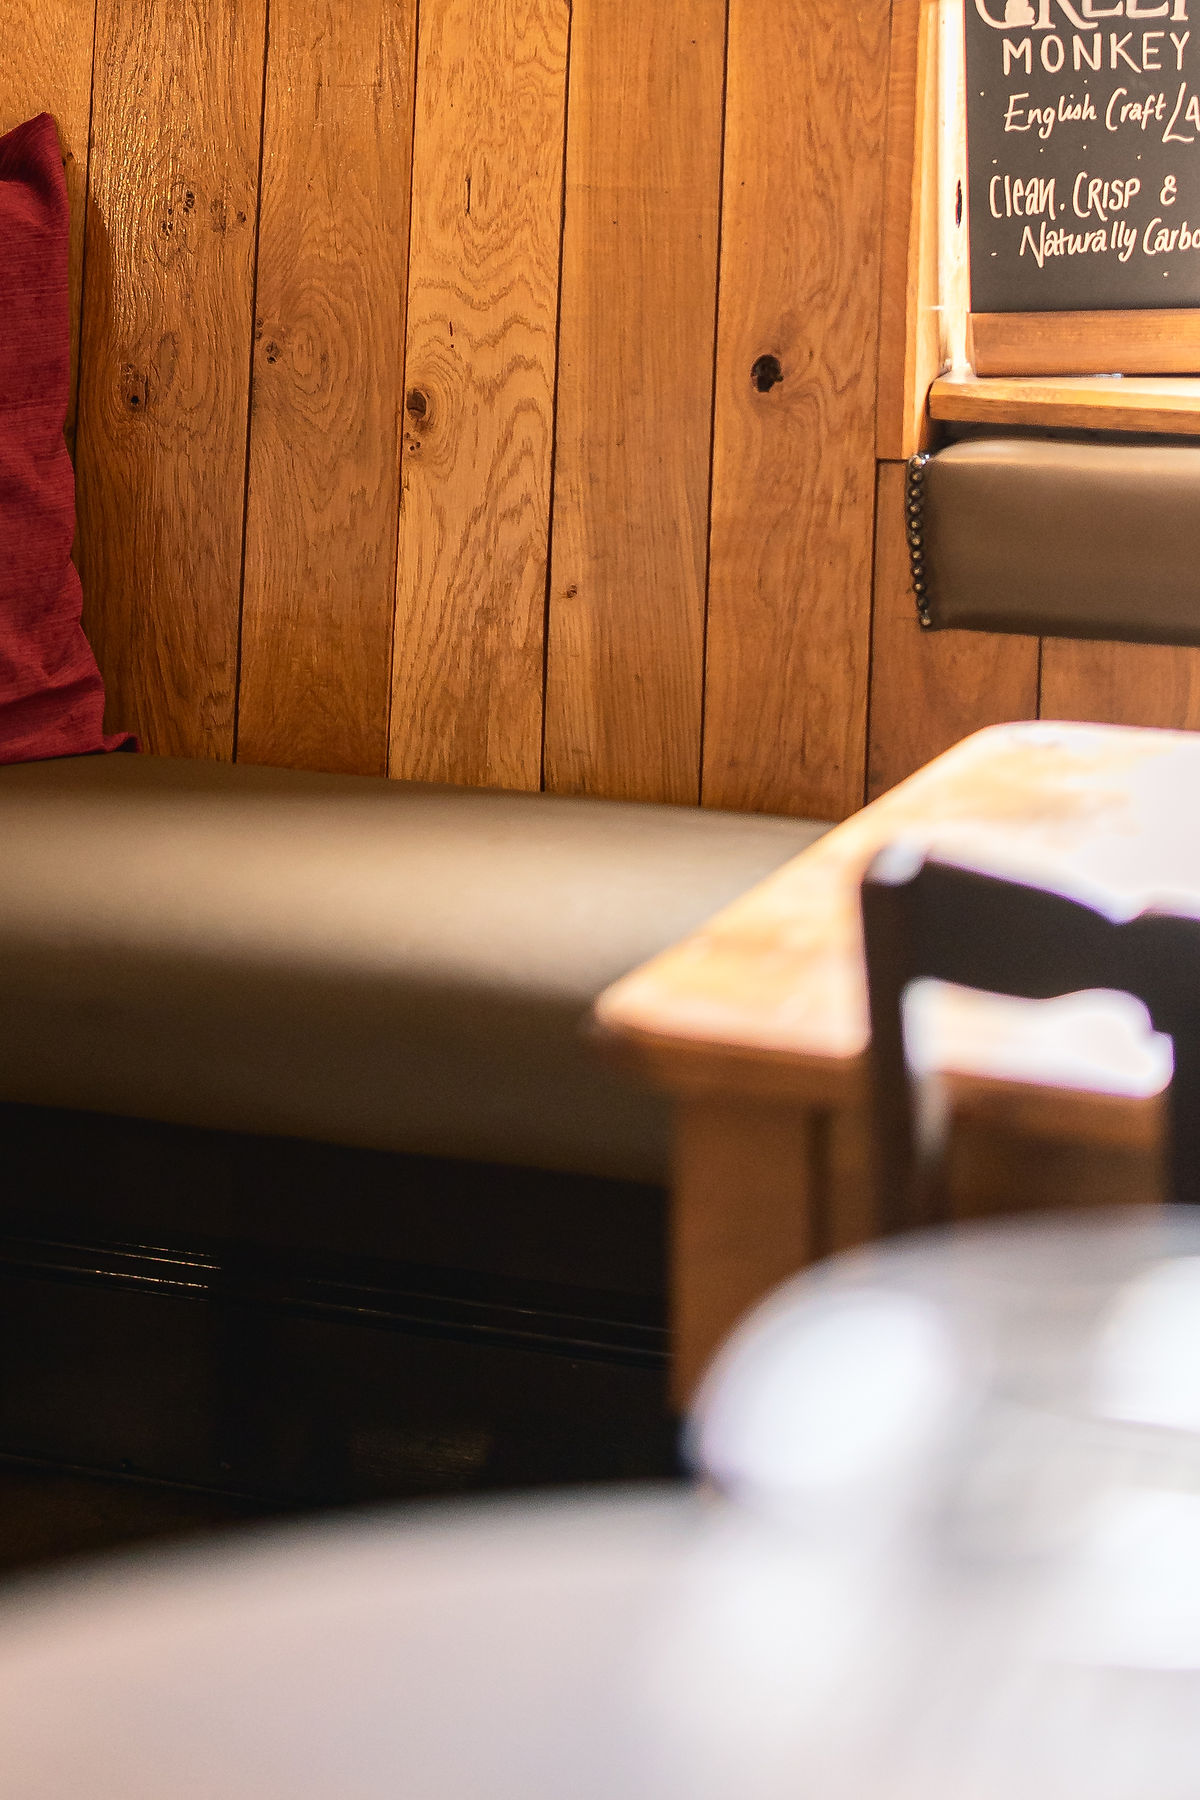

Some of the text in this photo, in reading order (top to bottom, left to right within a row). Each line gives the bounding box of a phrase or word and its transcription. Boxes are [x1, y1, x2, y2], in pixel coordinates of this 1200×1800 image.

[1002, 30, 1191, 77] MONKEY
[1003, 92, 1098, 140] English
[1105, 87, 1167, 132] Craft
[1159, 173, 1178, 207] &
[1019, 220, 1138, 269] Naturally
